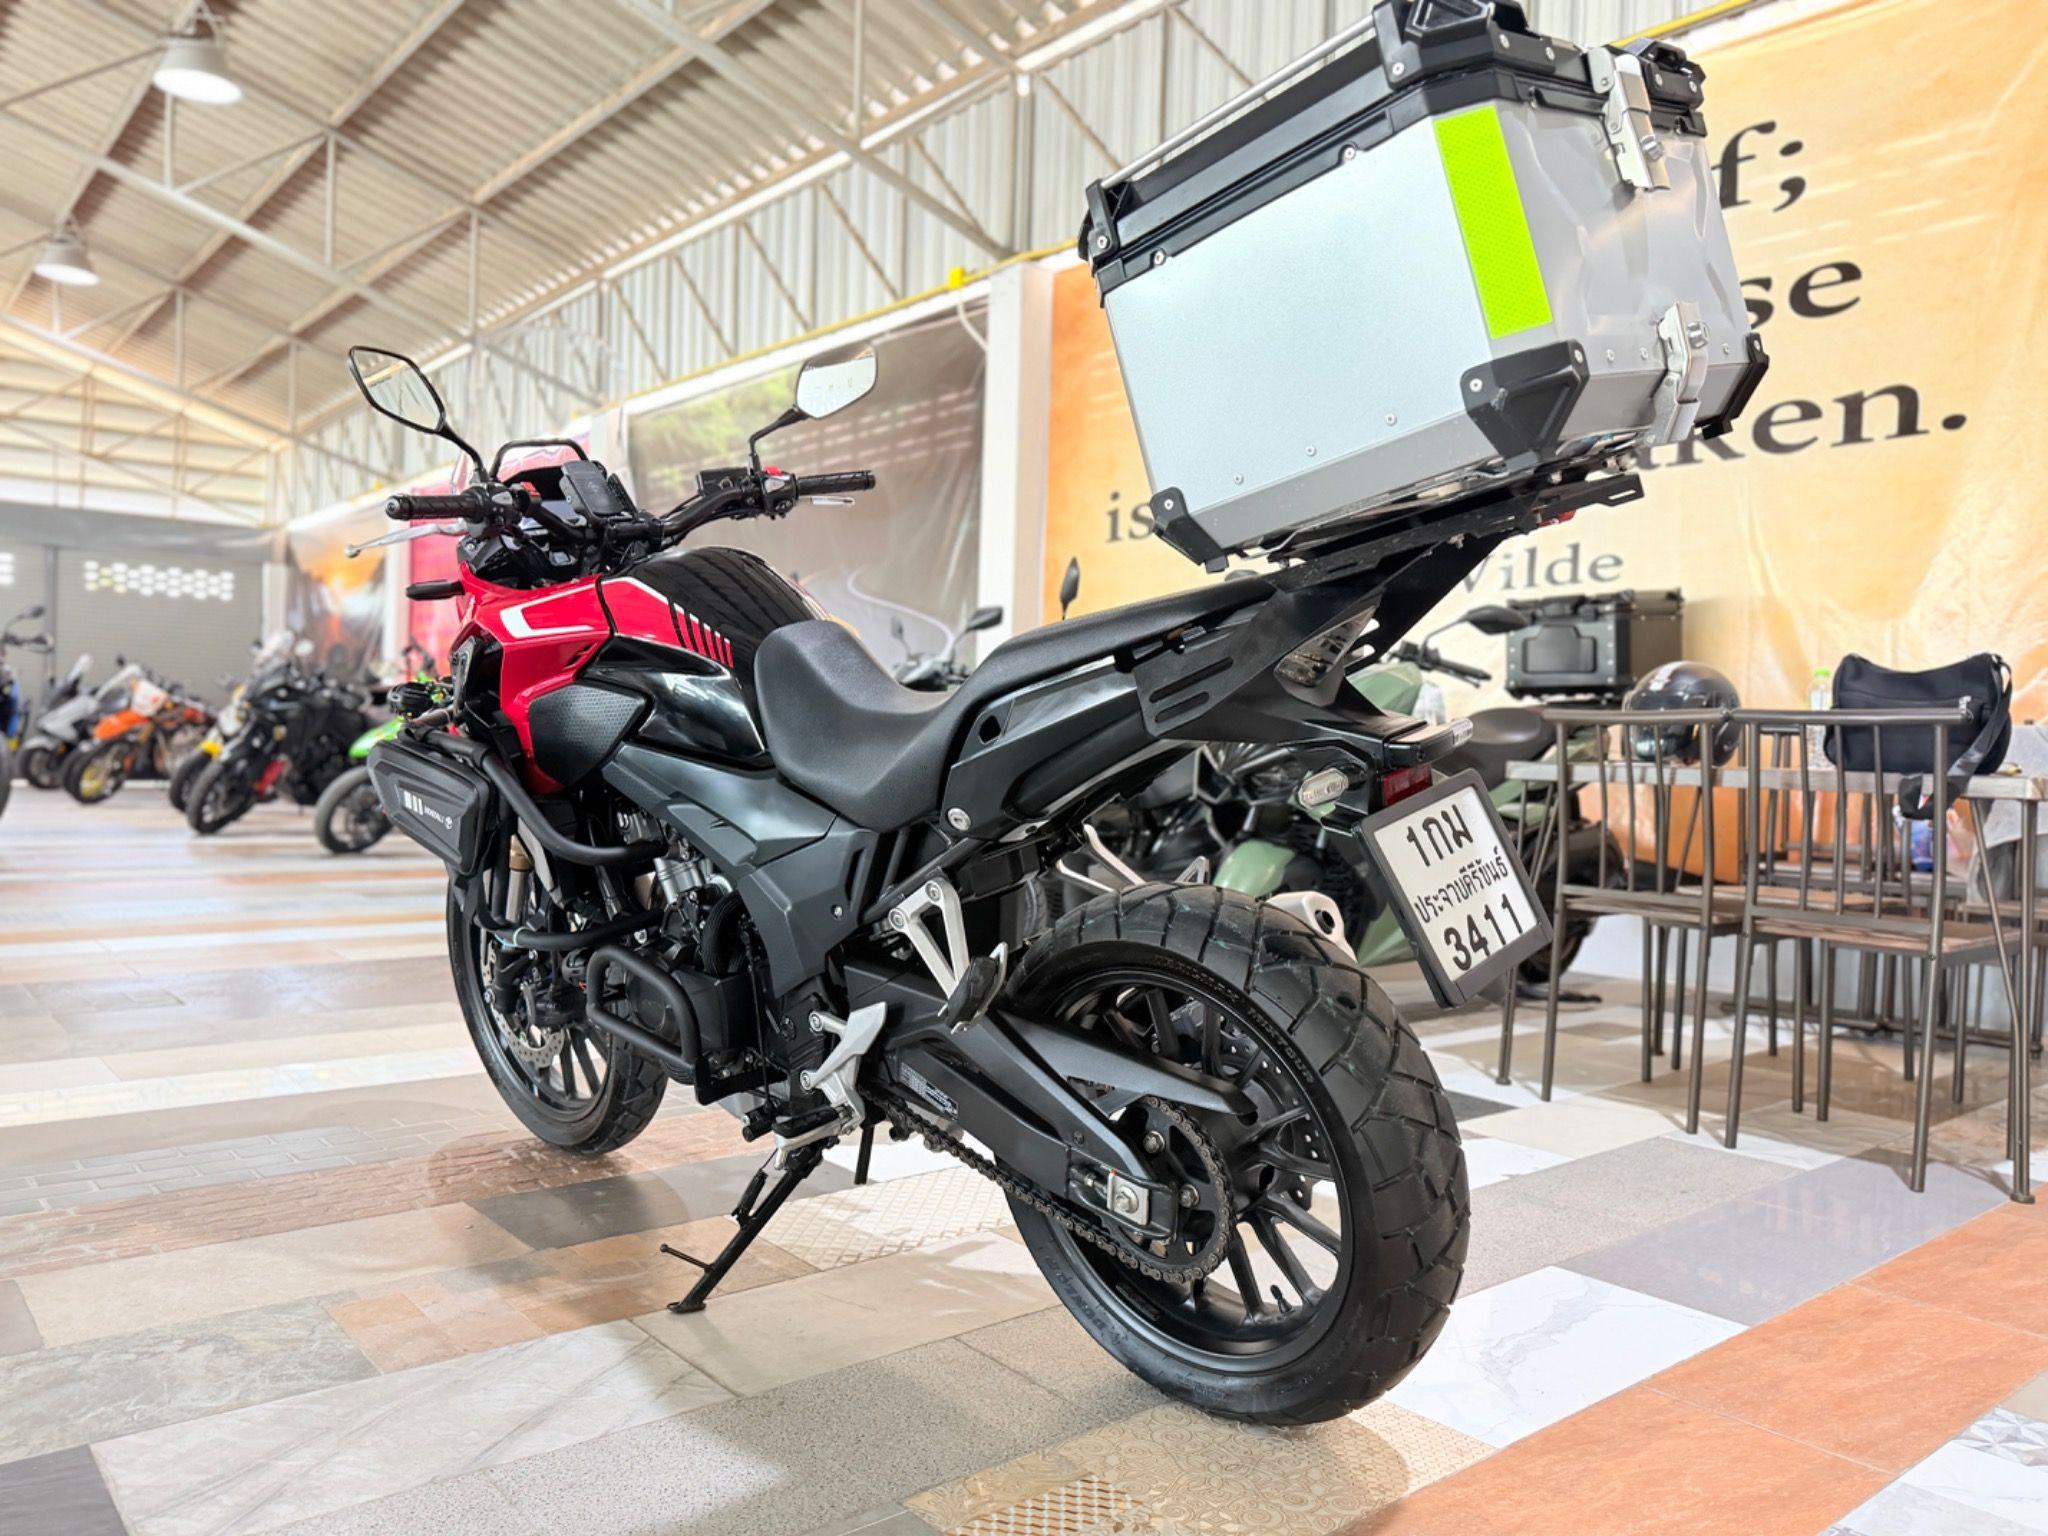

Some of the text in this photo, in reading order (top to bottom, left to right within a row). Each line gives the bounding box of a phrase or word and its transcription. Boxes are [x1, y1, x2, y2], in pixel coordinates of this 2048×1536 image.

[1105, 384, 1967, 543] is en.
[1406, 804, 1474, 867] 1กม
[1443, 893, 1524, 971] 3411
